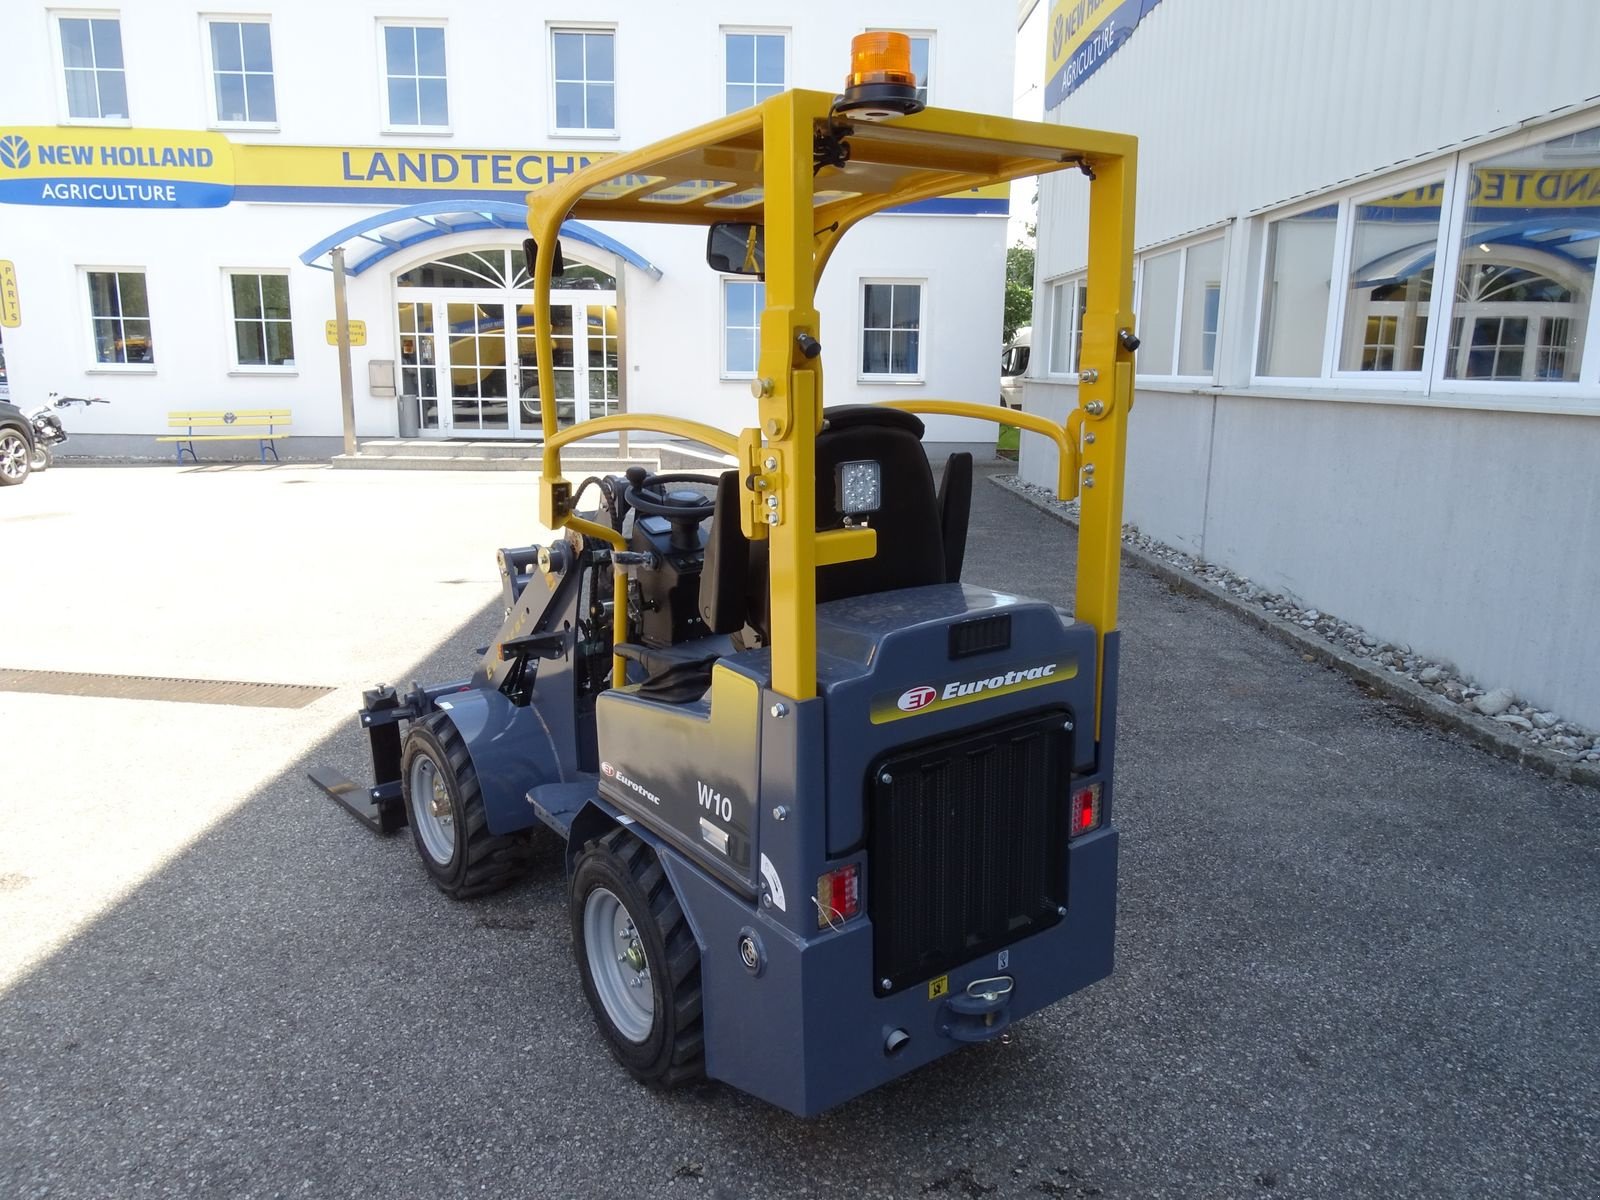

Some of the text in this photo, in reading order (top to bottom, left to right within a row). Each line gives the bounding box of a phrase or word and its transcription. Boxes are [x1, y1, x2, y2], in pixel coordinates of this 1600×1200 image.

[1064, 0, 1086, 44] NEW
[1061, 20, 1115, 91] AGRICULTURE
[38, 145, 213, 167] NEW HOLLAND
[42, 183, 177, 201] AGRICULTURE
[5, 267, 17, 320] PARTS
[942, 663, 1056, 700] Eurotrac
[616, 771, 660, 805] Eurotrac
[697, 780, 732, 822] W10
